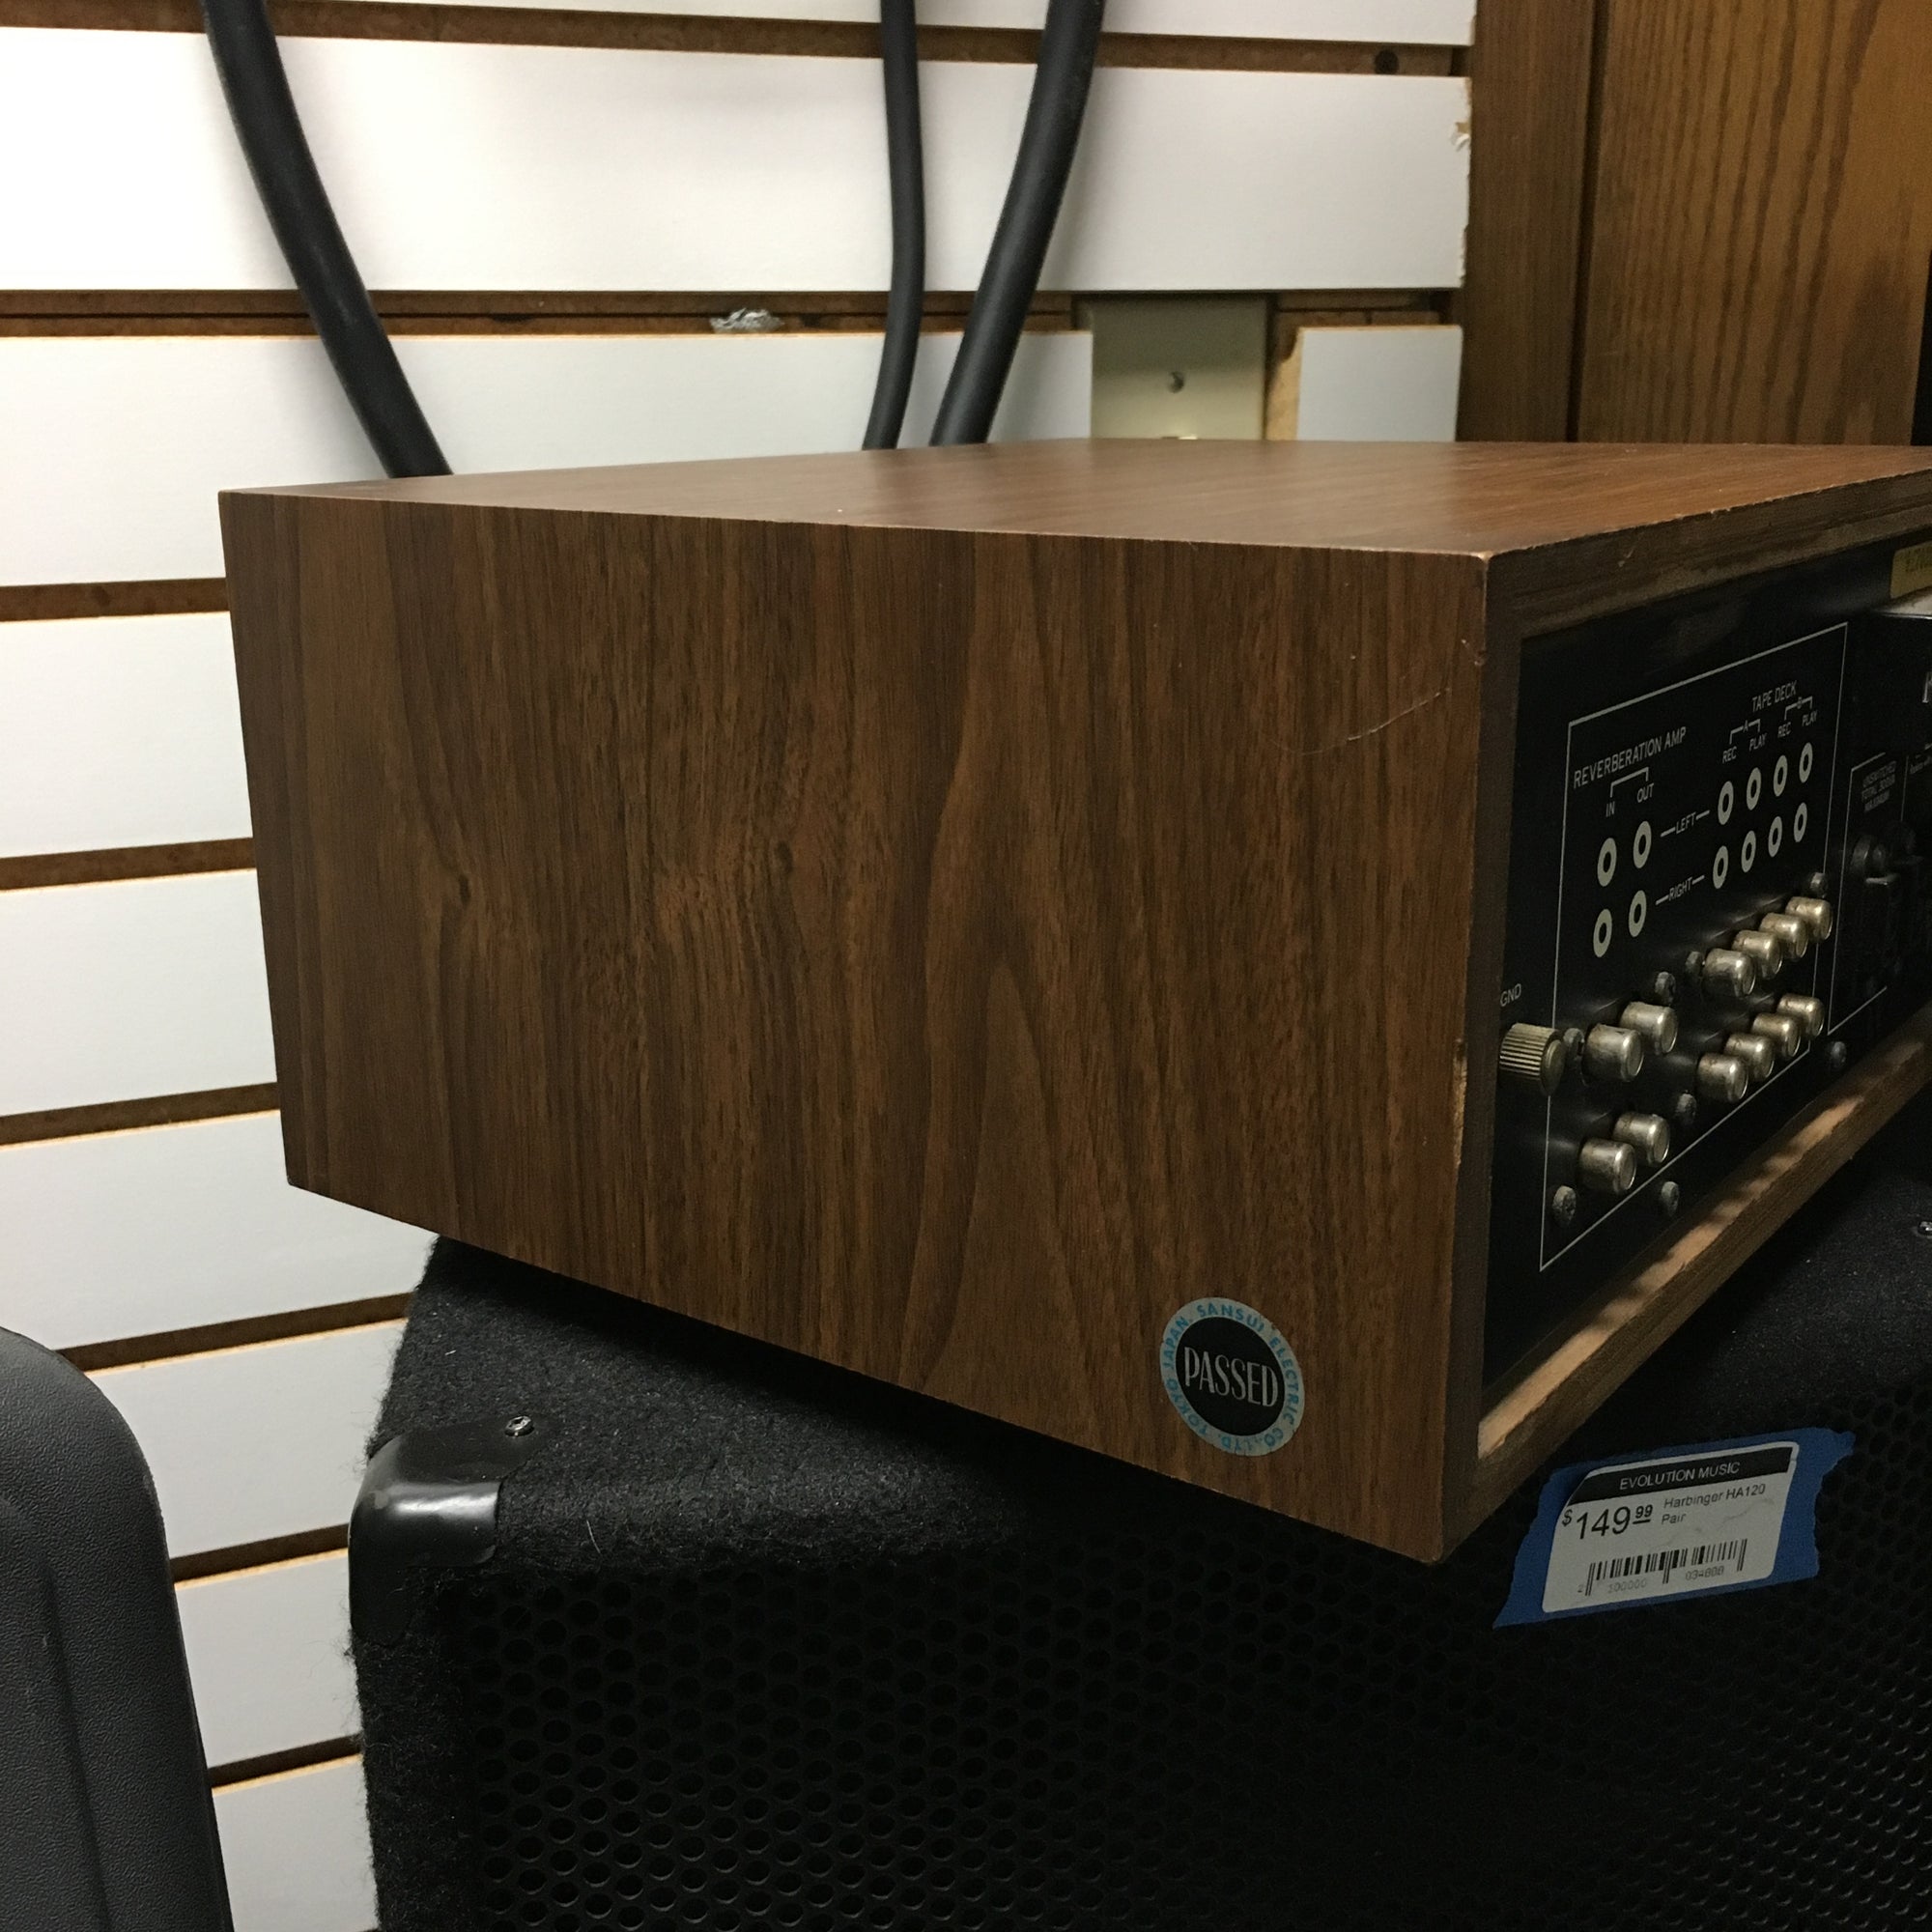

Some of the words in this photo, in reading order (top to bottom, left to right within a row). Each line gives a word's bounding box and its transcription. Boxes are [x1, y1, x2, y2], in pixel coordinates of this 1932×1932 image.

[1751, 690, 1774, 713] TAPE
[1774, 680, 1797, 704] DECK
[1777, 722, 1791, 737] REC
[1802, 710, 1818, 726] PLAY
[1749, 732, 1766, 752] PLAY
[1574, 735, 1662, 789] REVERBERATION
[1663, 726, 1687, 750] AMP
[1722, 746, 1737, 763] REC
[1636, 782, 1655, 803] OUT
[1605, 801, 1615, 817] IN
[1676, 811, 1697, 834] LEFT
[1668, 877, 1691, 902] RIGHT
[1500, 983, 1521, 1008] GND
[1197, 1303, 1264, 1333] SANSUI
[1269, 1337, 1299, 1426] ELECTRIC
[1184, 1347, 1278, 1407] PASSED
[1619, 1468, 1695, 1491] EVOLUTION
[1697, 1462, 1741, 1479] MUSIC
[1663, 1492, 1725, 1512] Harbinger
[1725, 1483, 1767, 1501] HA120
[1662, 1513, 1687, 1525] Pair
